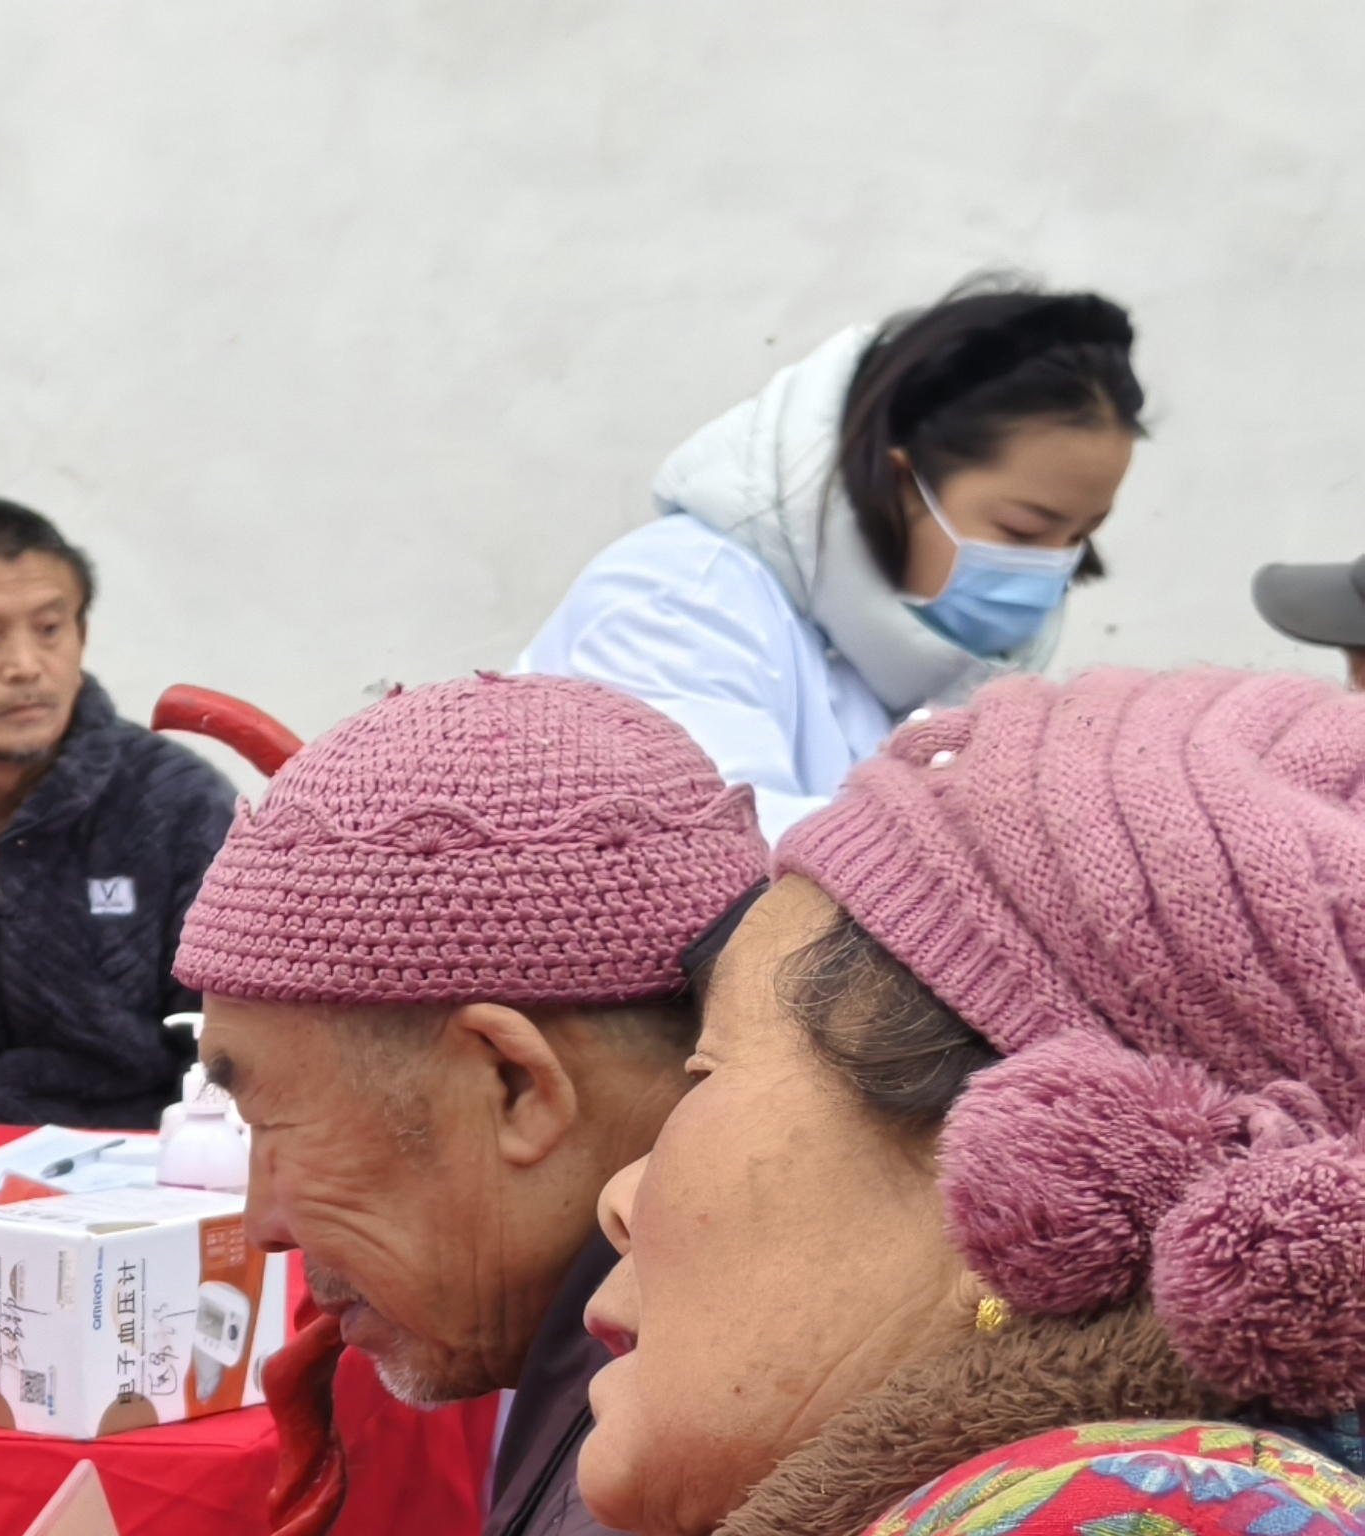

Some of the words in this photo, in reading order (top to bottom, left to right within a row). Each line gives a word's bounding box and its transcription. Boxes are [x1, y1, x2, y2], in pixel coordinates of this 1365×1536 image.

[92, 1274, 103, 1330] OMRON
[116, 1260, 137, 1404] 电子血压计
